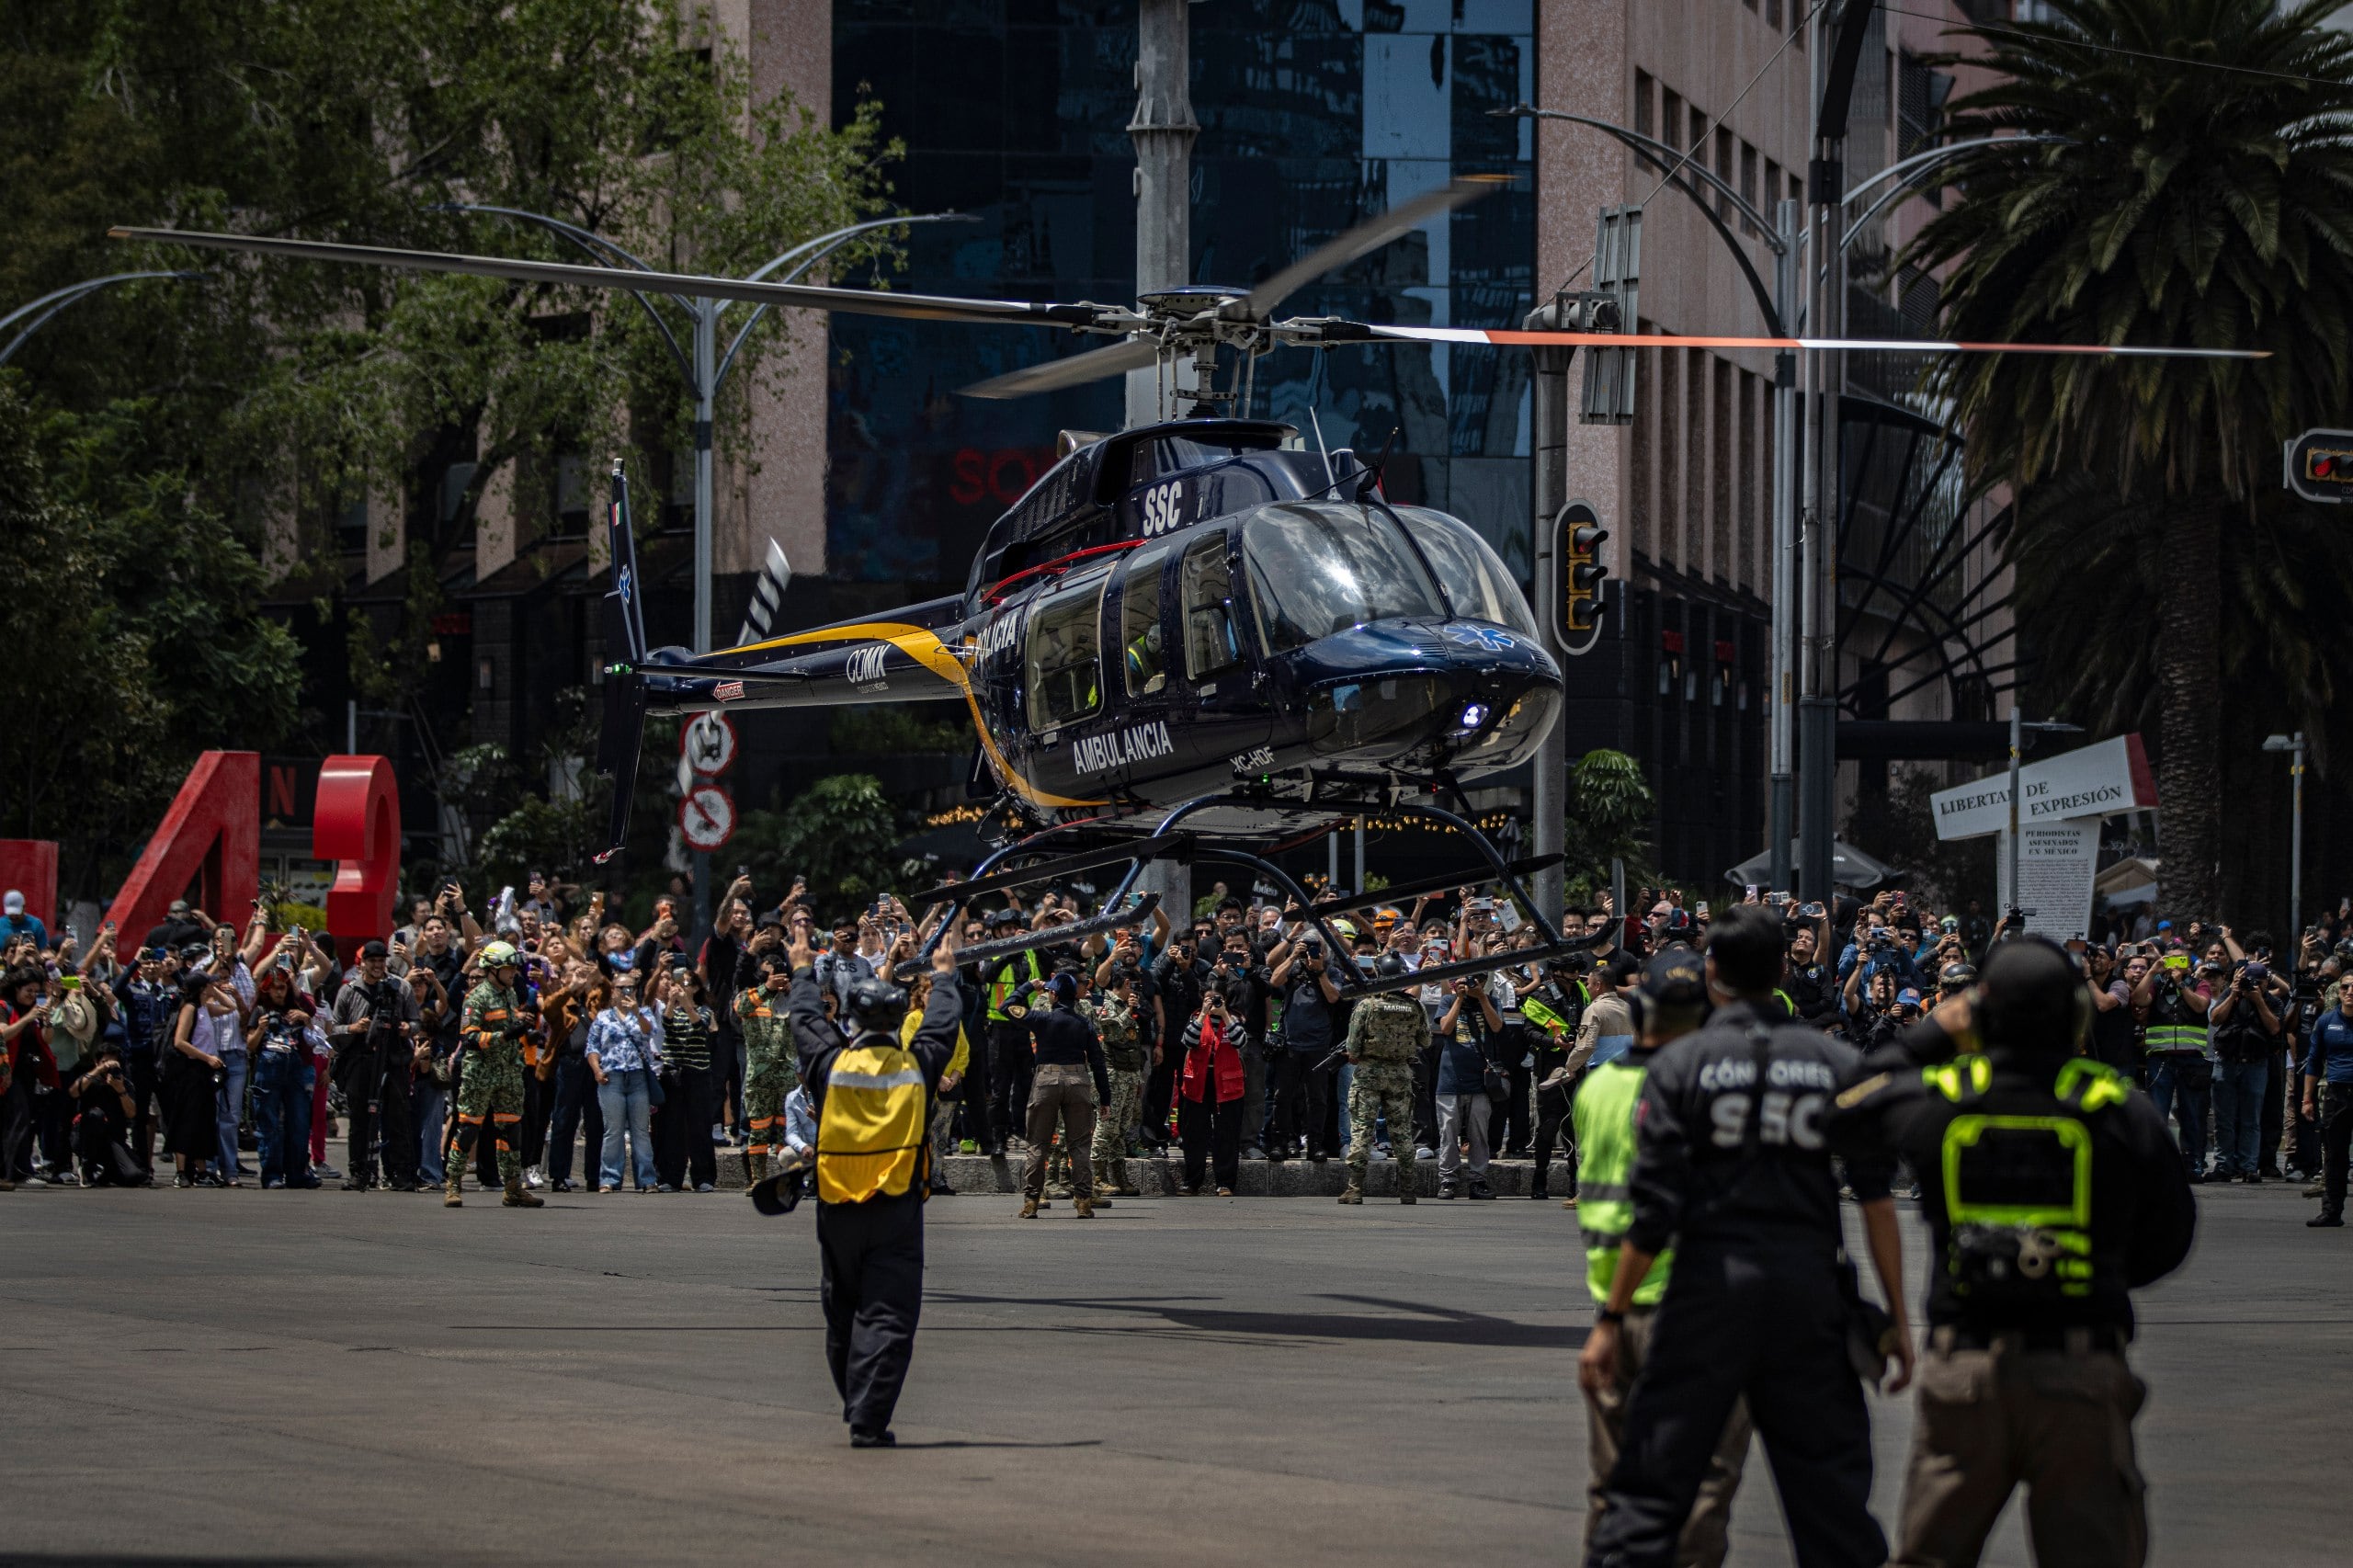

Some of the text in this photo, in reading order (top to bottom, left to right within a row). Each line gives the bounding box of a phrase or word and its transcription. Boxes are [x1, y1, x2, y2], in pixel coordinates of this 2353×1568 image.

[1142, 481, 1182, 537] SSC
[974, 612, 1017, 669] POLICIA
[846, 643, 892, 684] CDMX
[717, 686, 742, 699] DANGER
[1074, 720, 1174, 775] AMBULANCIA
[1229, 745, 1275, 773] XC-HDF
[1940, 781, 2049, 816] LIBERTA DE
[2030, 786, 2121, 816] EXPRESIÓN
[2025, 830, 2081, 838] PERIODISTAS
[2029, 838, 2079, 846] ASESINADOS
[1383, 1005, 1413, 1013] MARINA
[1699, 1056, 1836, 1091] CÓNORES
